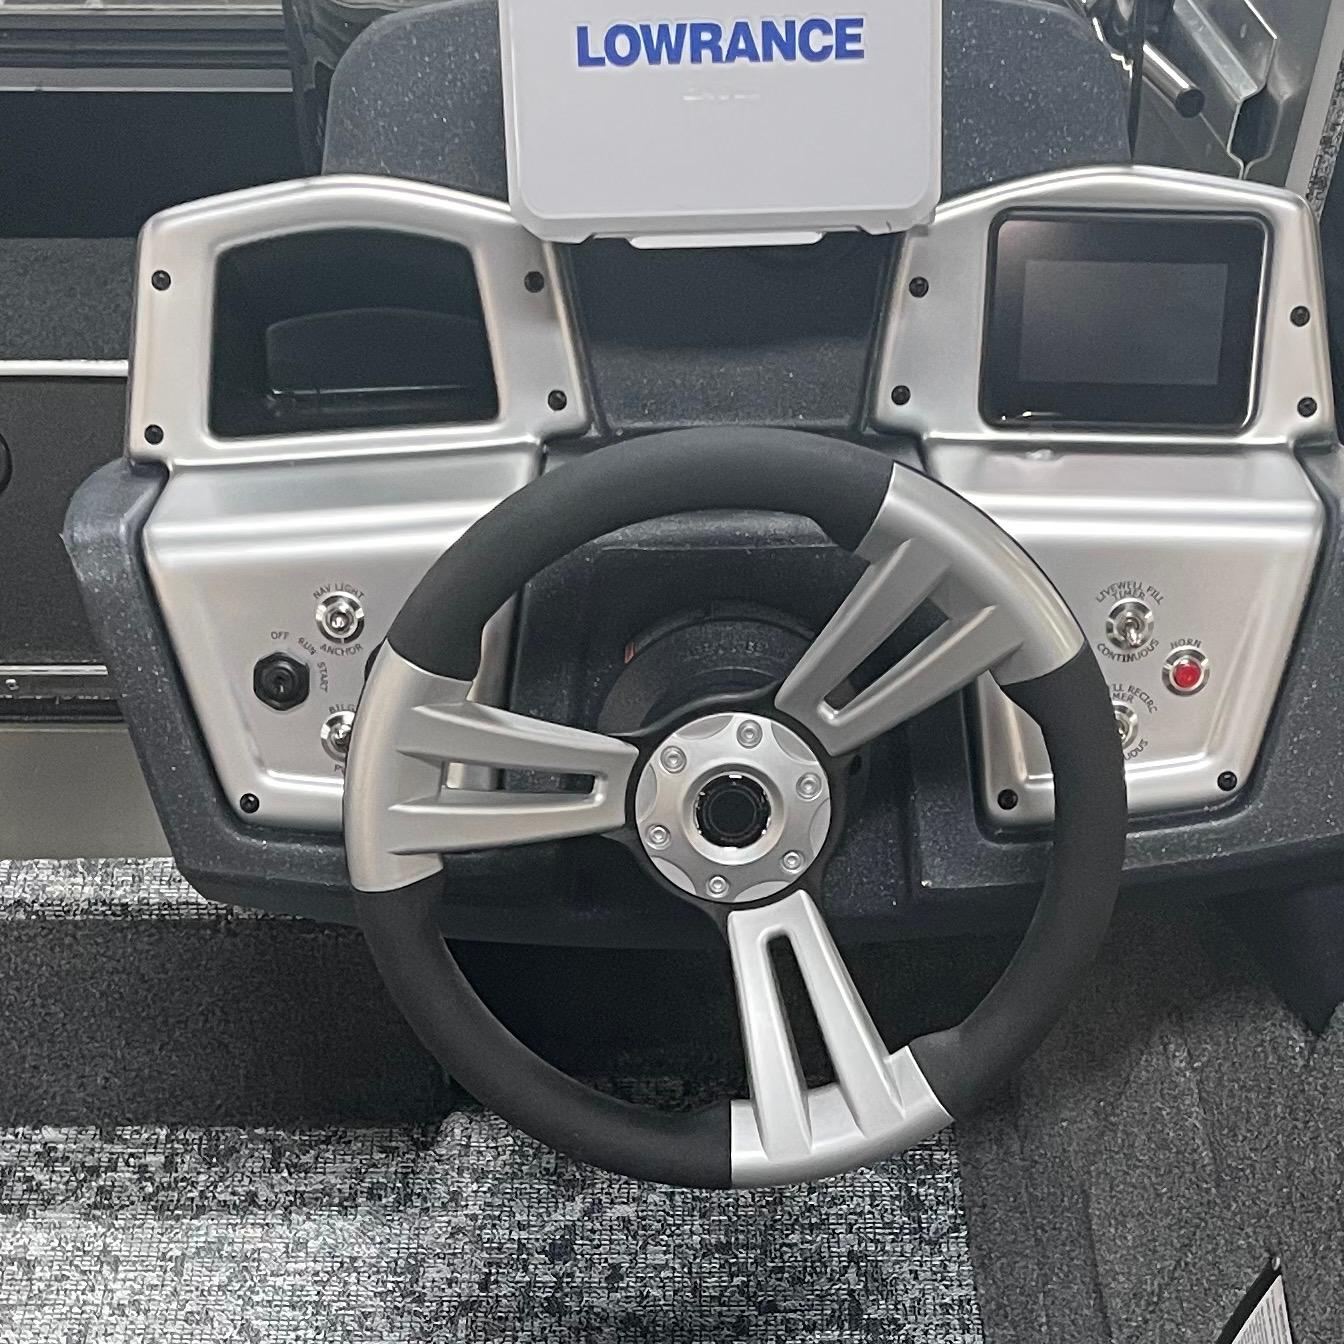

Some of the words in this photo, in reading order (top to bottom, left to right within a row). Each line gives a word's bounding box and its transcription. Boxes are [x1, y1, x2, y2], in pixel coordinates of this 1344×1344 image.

[575, 17, 865, 68] LOWRANCE
[313, 584, 331, 599] NAV
[335, 583, 365, 599] LIGHT
[1096, 581, 1143, 603] LIVEWELL
[1146, 586, 1164, 605] FILL
[1112, 589, 1146, 600] TIMER
[270, 631, 289, 640] OFF
[297, 637, 317, 656] RUN
[320, 643, 363, 656] ANCHOR
[1097, 639, 1160, 663] CONTINUOUS
[1170, 638, 1202, 650] HORN
[317, 661, 329, 693] START
[1112, 692, 1134, 703] MER
[1127, 685, 1158, 714] RECIRC
[328, 703, 355, 715] BILG
